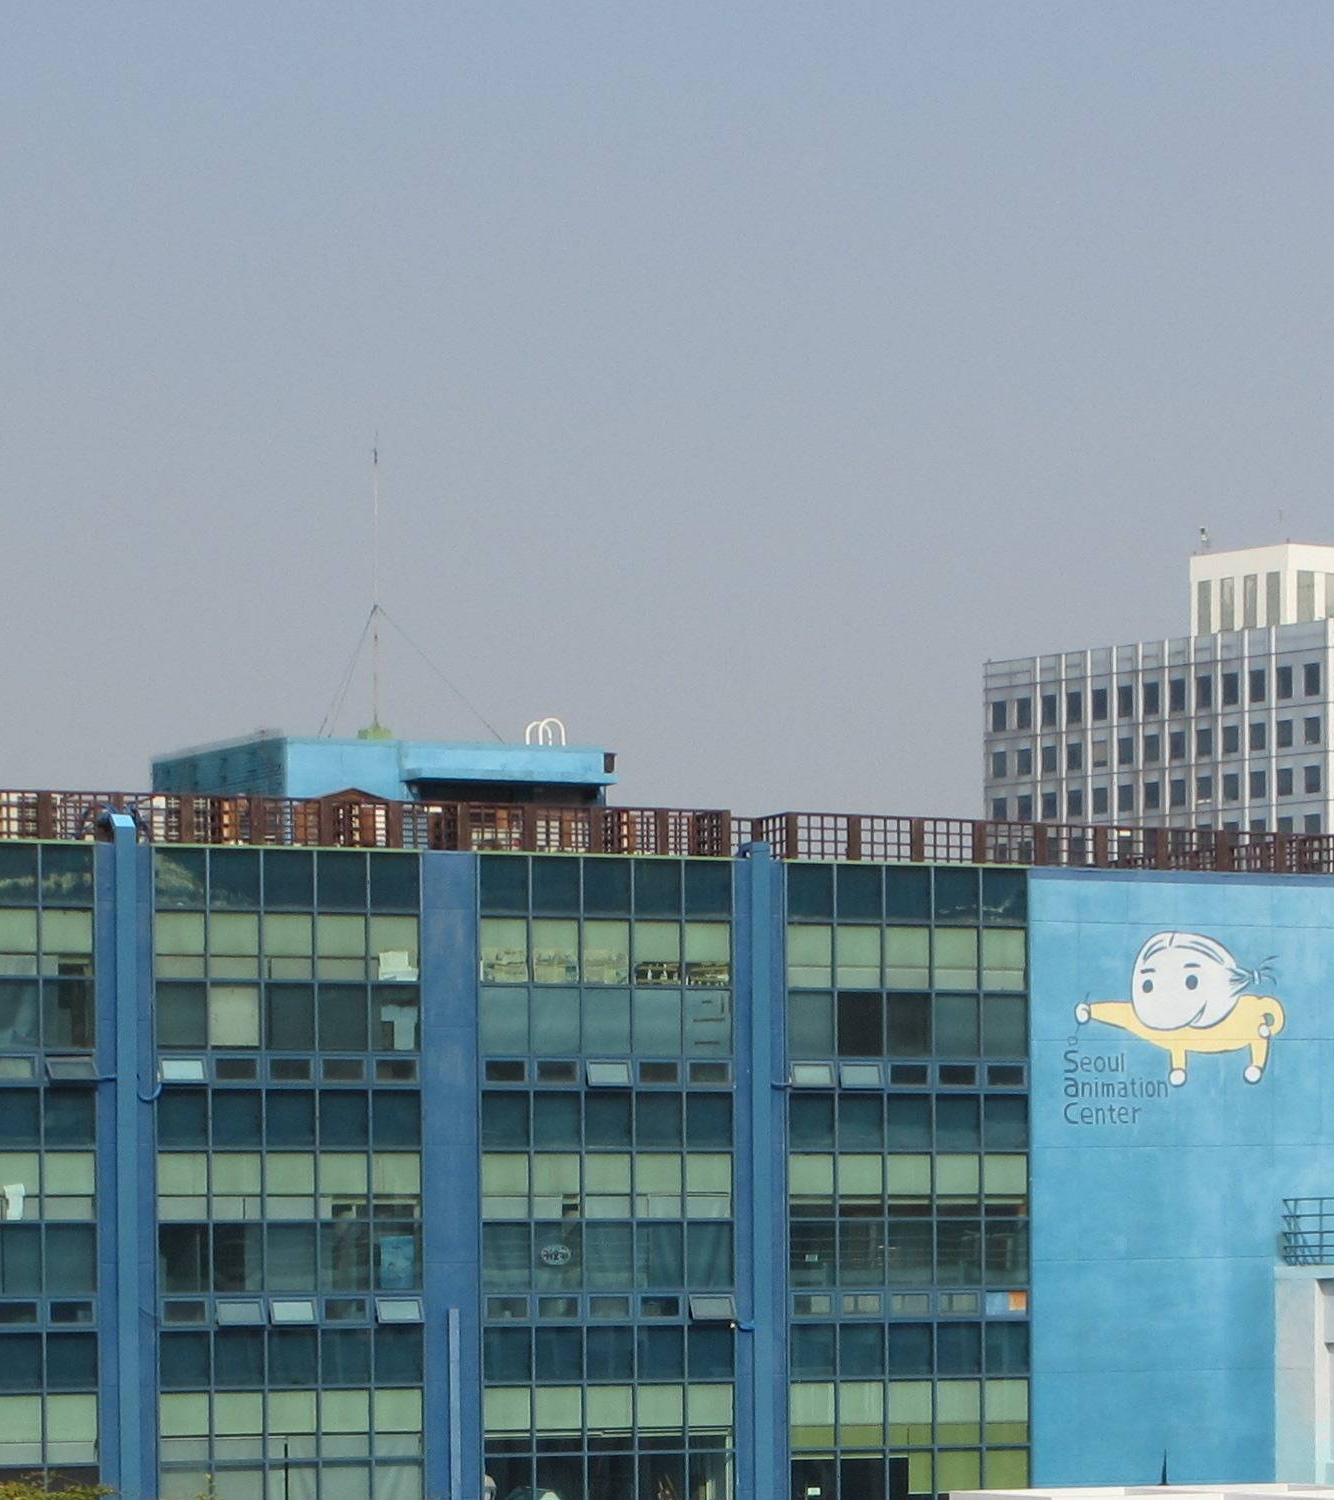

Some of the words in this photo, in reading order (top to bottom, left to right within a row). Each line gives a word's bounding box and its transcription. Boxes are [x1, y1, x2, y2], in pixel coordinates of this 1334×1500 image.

[1063, 1050, 1125, 1073] Seoul
[1063, 1077, 1169, 1098] animation
[1063, 1102, 1142, 1125] Center
